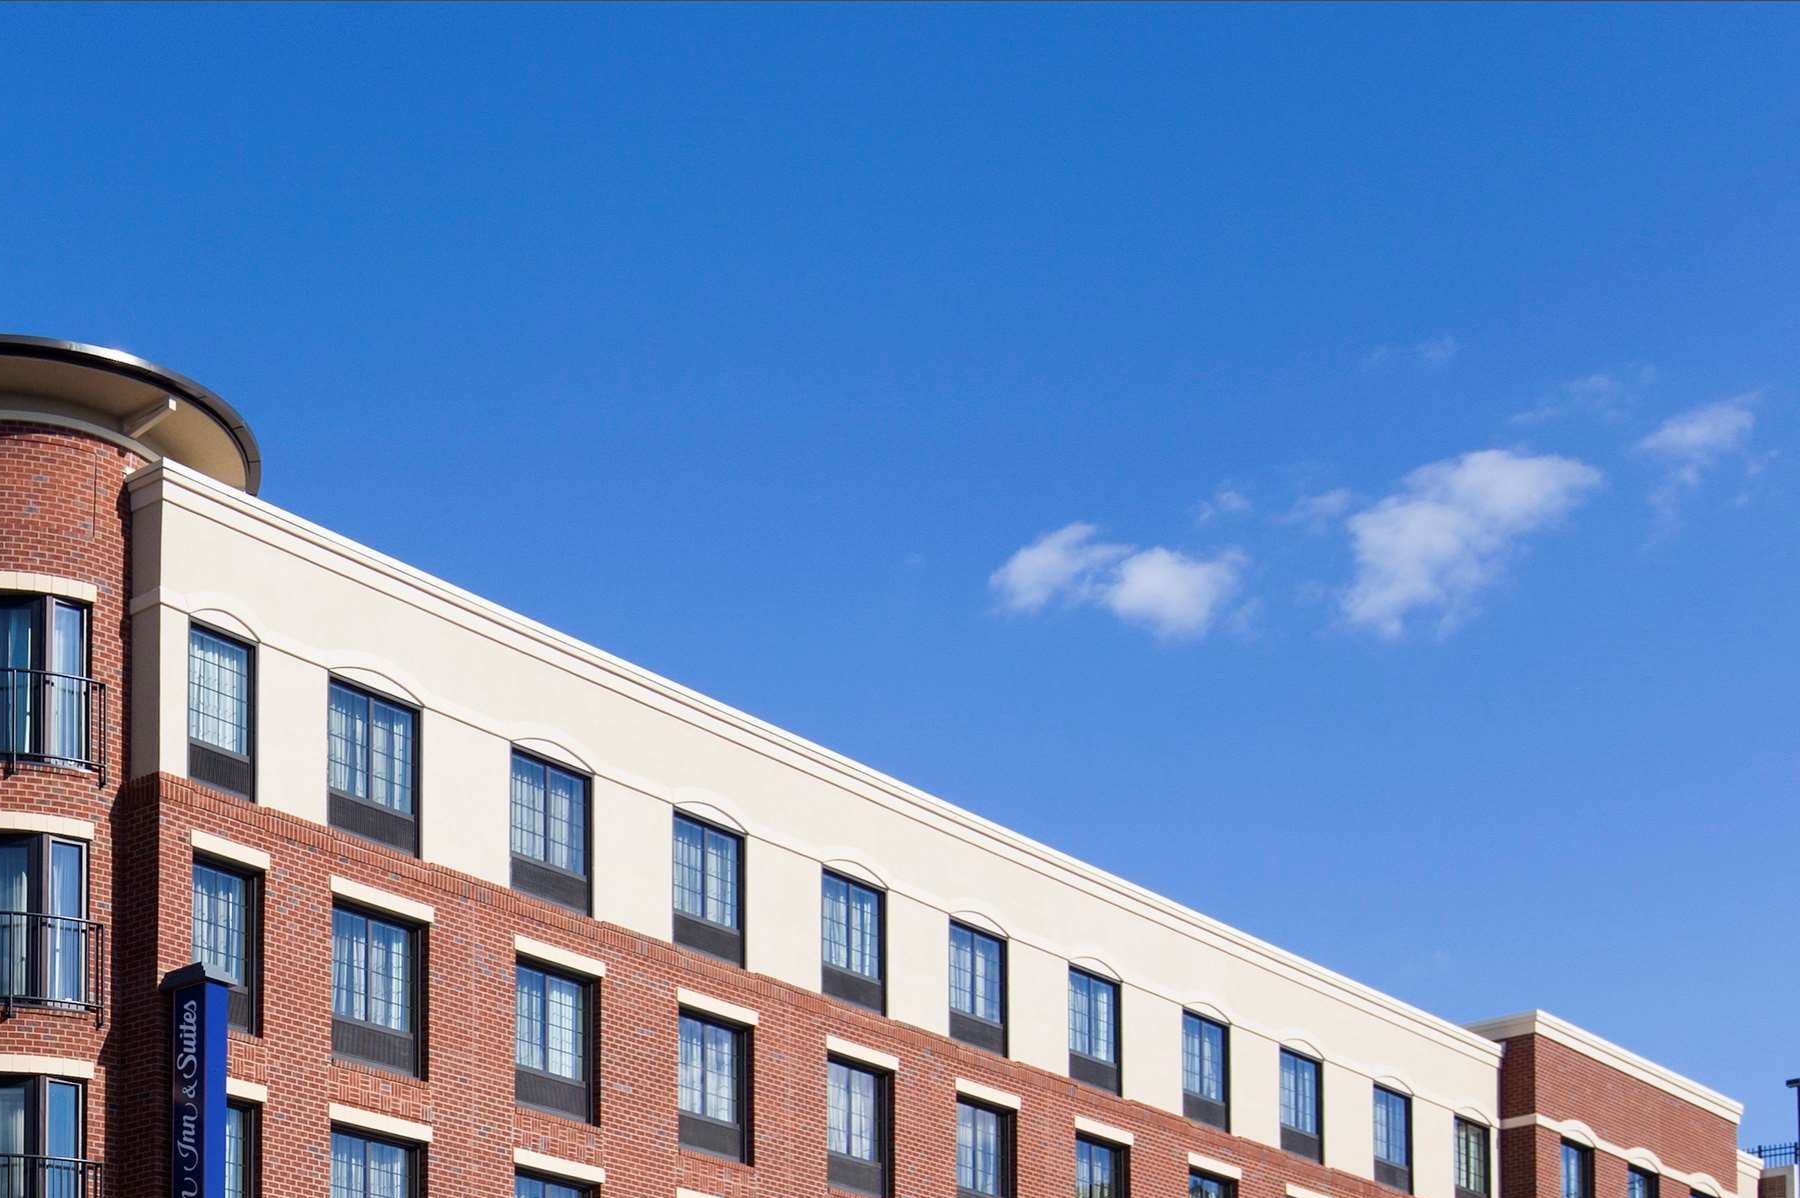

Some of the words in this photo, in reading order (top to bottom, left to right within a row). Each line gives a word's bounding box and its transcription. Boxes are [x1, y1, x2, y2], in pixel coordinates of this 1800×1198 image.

[176, 1000, 198, 1079] Suites
[182, 1079, 198, 1098] &
[176, 1102, 198, 1171] Inn
